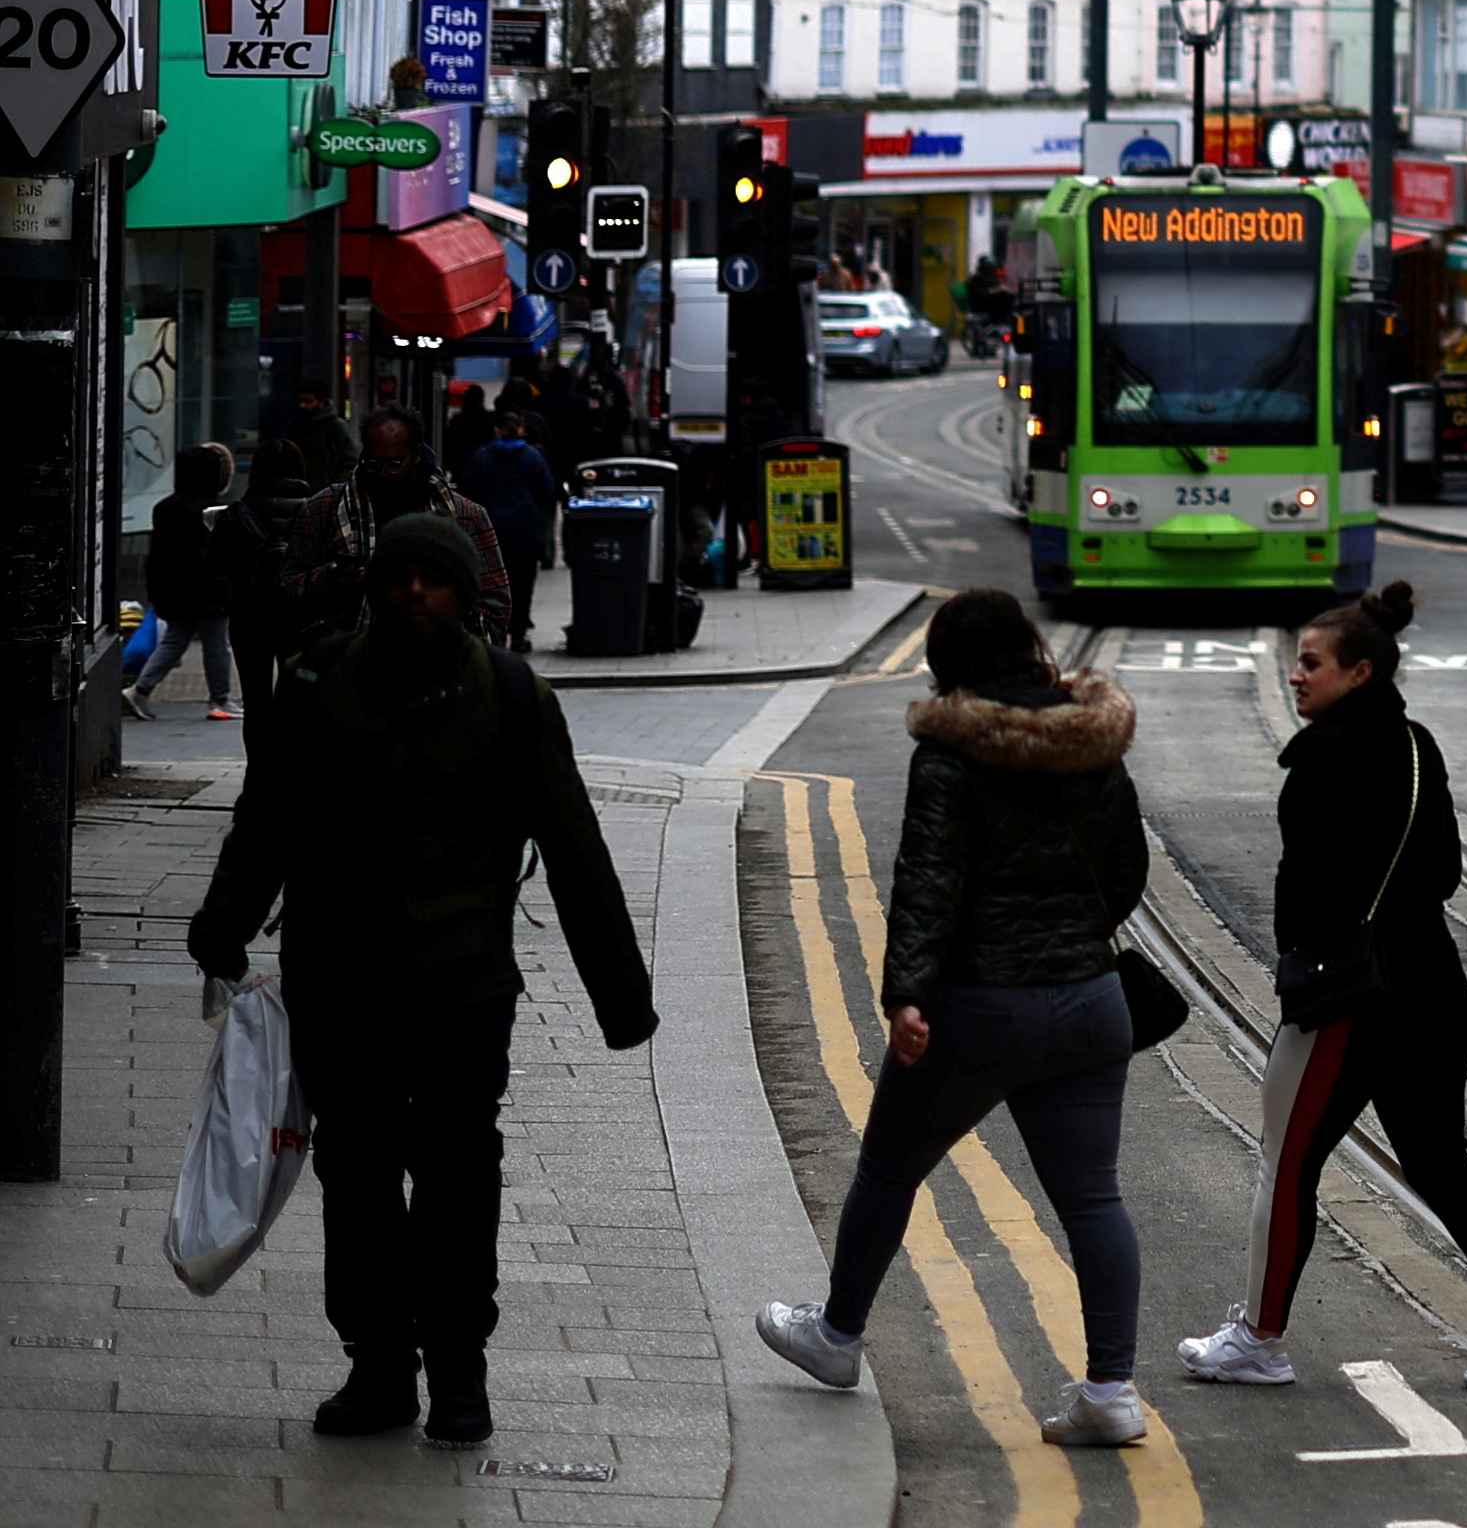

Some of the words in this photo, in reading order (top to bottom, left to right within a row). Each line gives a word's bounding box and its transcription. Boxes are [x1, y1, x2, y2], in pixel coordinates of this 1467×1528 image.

[431, 4, 478, 26] Fish
[0, 7, 91, 71] 20
[424, 25, 482, 50] Shop
[223, 41, 312, 70] KFC
[430, 51, 474, 67] Fresh
[424, 79, 478, 96] Frozen
[320, 130, 427, 154] Specsavers
[1103, 207, 1158, 241] New
[1166, 207, 1304, 241] Addington
[1175, 486, 1231, 506] 2534
